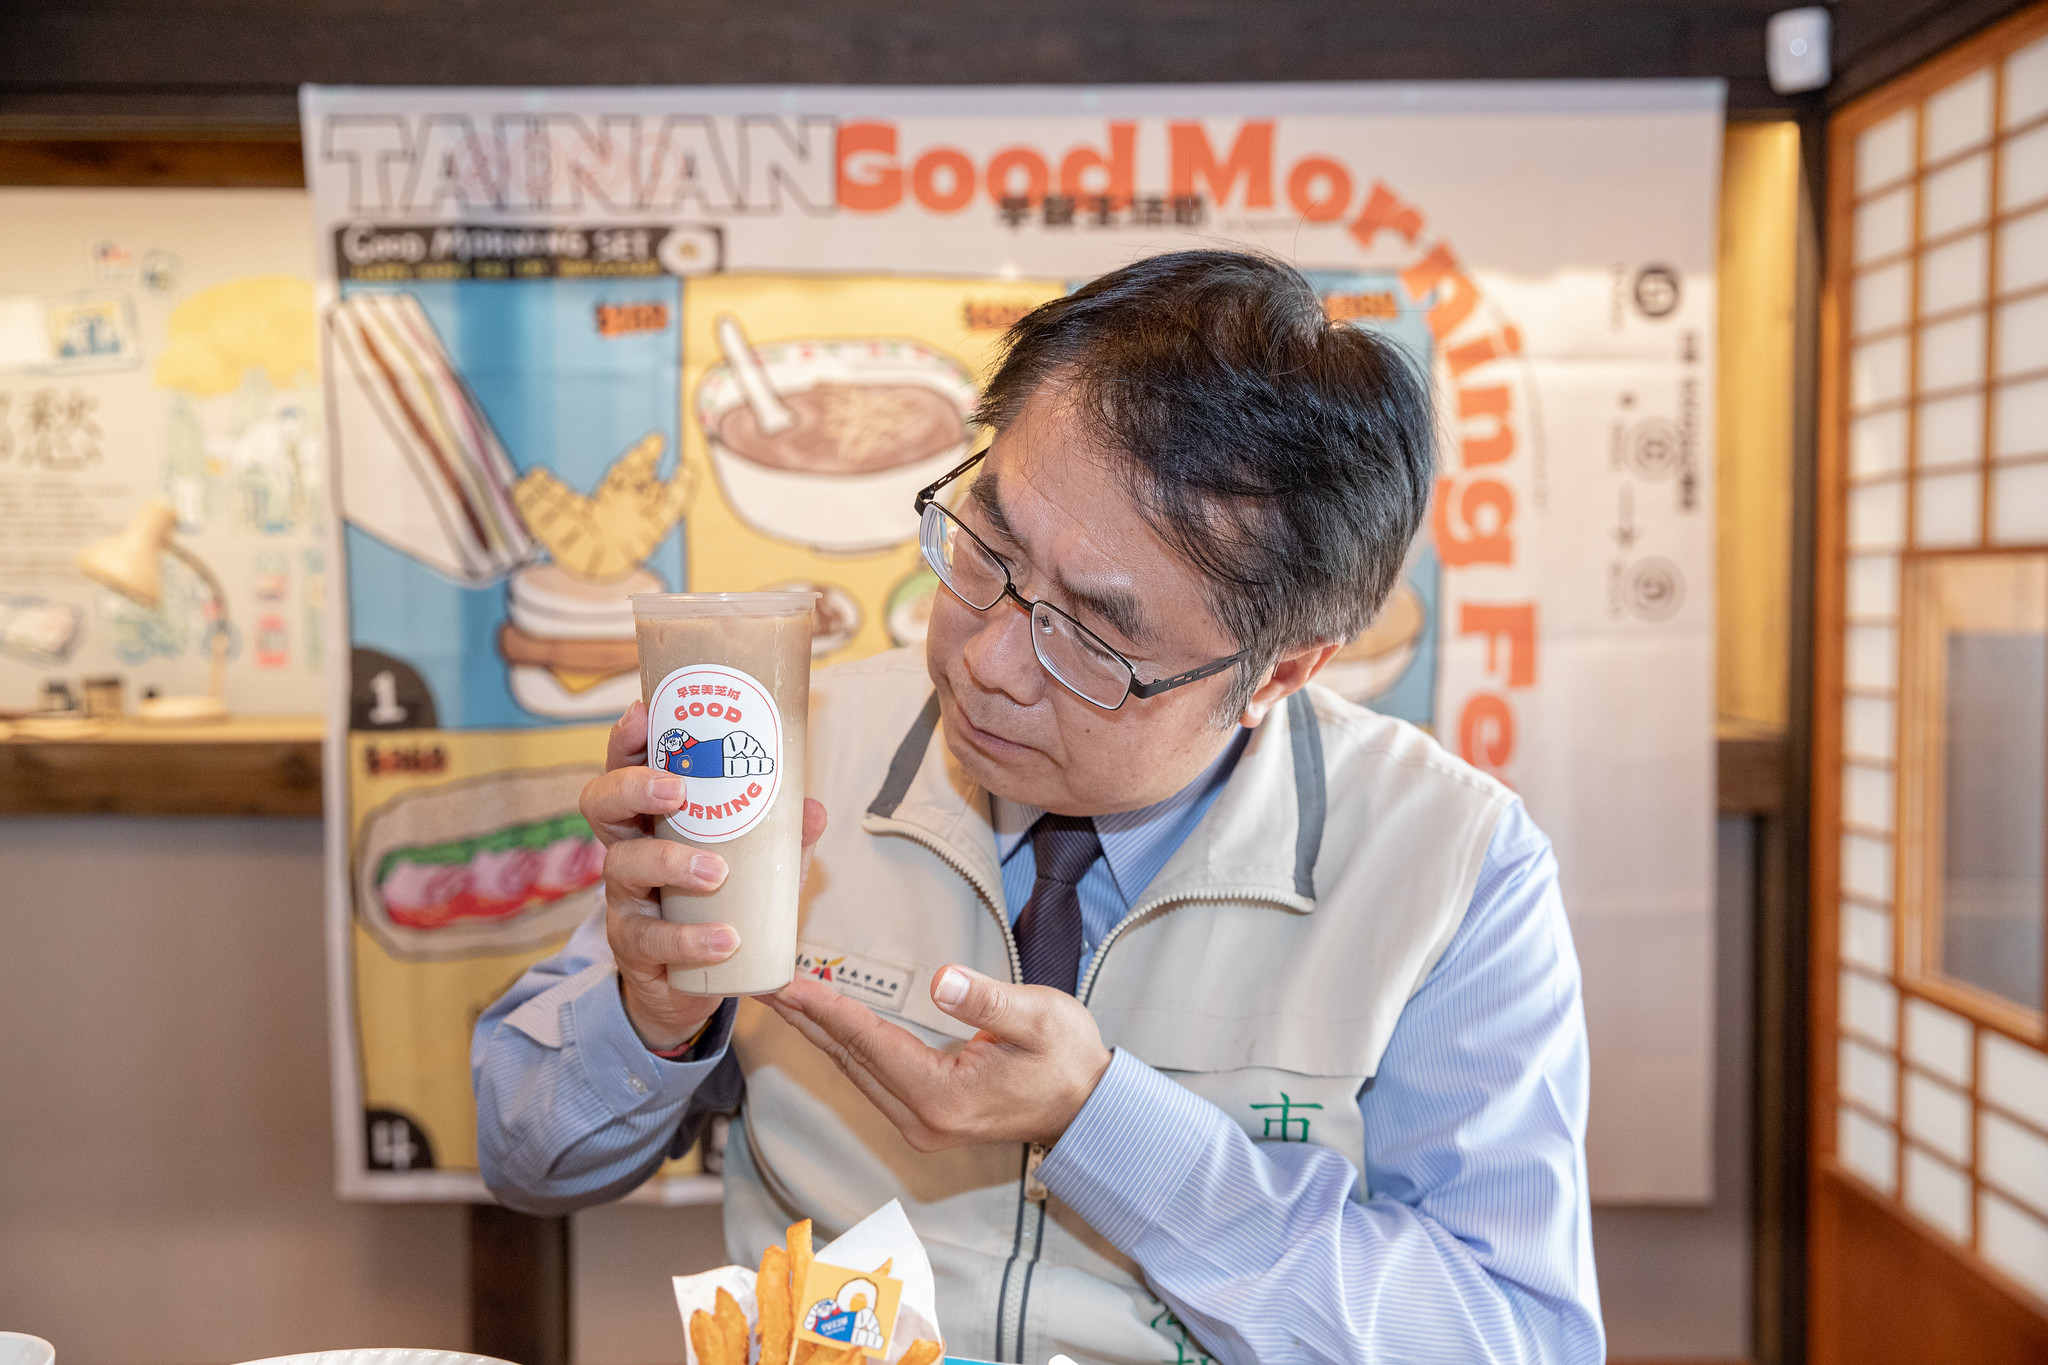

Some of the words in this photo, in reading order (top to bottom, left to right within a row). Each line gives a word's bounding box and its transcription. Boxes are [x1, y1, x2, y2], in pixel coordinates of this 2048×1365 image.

[322, 113, 838, 214] TAINAN
[836, 117, 1138, 215] Good
[1168, 117, 1521, 570] Morning
[677, 684, 741, 702] 早安美芝城
[674, 702, 742, 723] GOOD
[1249, 1091, 1323, 1142] 市
